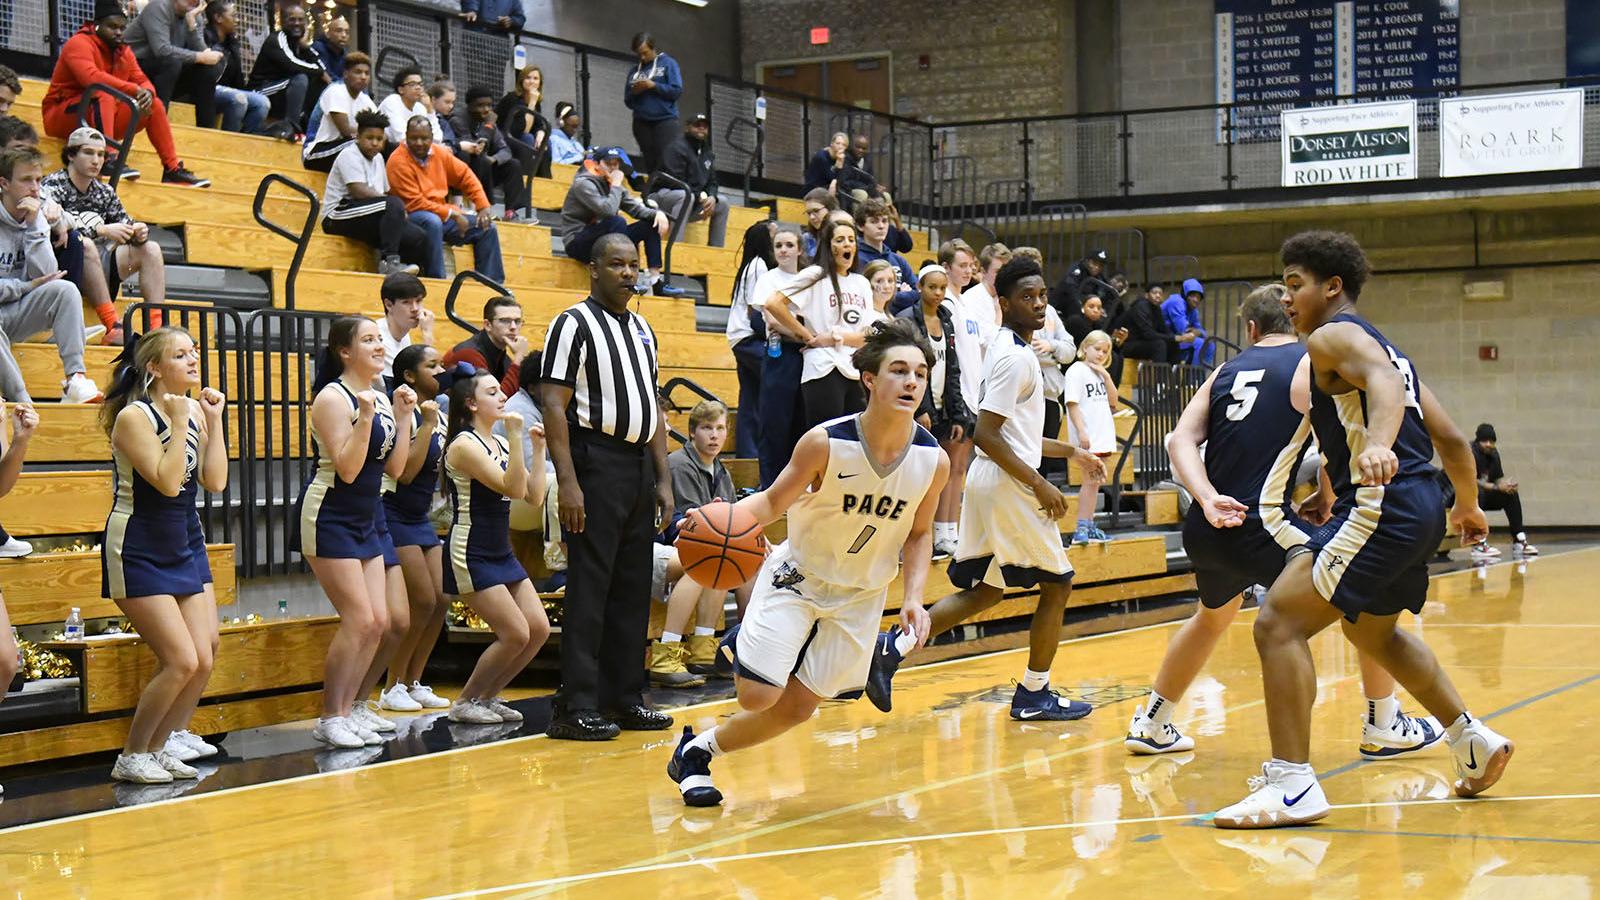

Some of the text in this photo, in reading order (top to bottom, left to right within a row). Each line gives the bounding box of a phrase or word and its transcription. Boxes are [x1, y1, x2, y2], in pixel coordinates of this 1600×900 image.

[1383, 2, 1410, 11] COOK
[1264, 9, 1310, 21] DOUGLASS
[1265, 24, 1288, 33] YOW
[1391, 27, 1419, 37] PAYNE
[1432, 24, 1457, 34] 19:32
[1384, 40, 1413, 50] MILLER
[1261, 48, 1301, 59] GARLAND
[1387, 52, 1429, 63] GARLAND
[1262, 62, 1291, 72] SMOOT
[1383, 66, 1414, 77] BIZZELL
[1235, 78, 1256, 88] 2012
[1266, 74, 1301, 85] ROGERS
[1357, 83, 1378, 93] 2018
[1390, 79, 1414, 90] ROSS
[1261, 88, 1301, 100] JOHNSON
[1472, 99, 1565, 114] Supporting Pace Athletics
[1290, 131, 1409, 153] DORSEY ALSTON
[1459, 126, 1564, 149] ROARK
[1294, 161, 1407, 184] ROD WHITE
[843, 309, 860, 324] G
[1085, 382, 1107, 398] PAC
[1225, 369, 1265, 421] 5
[842, 493, 908, 521] PACE
[846, 524, 877, 554] 1
